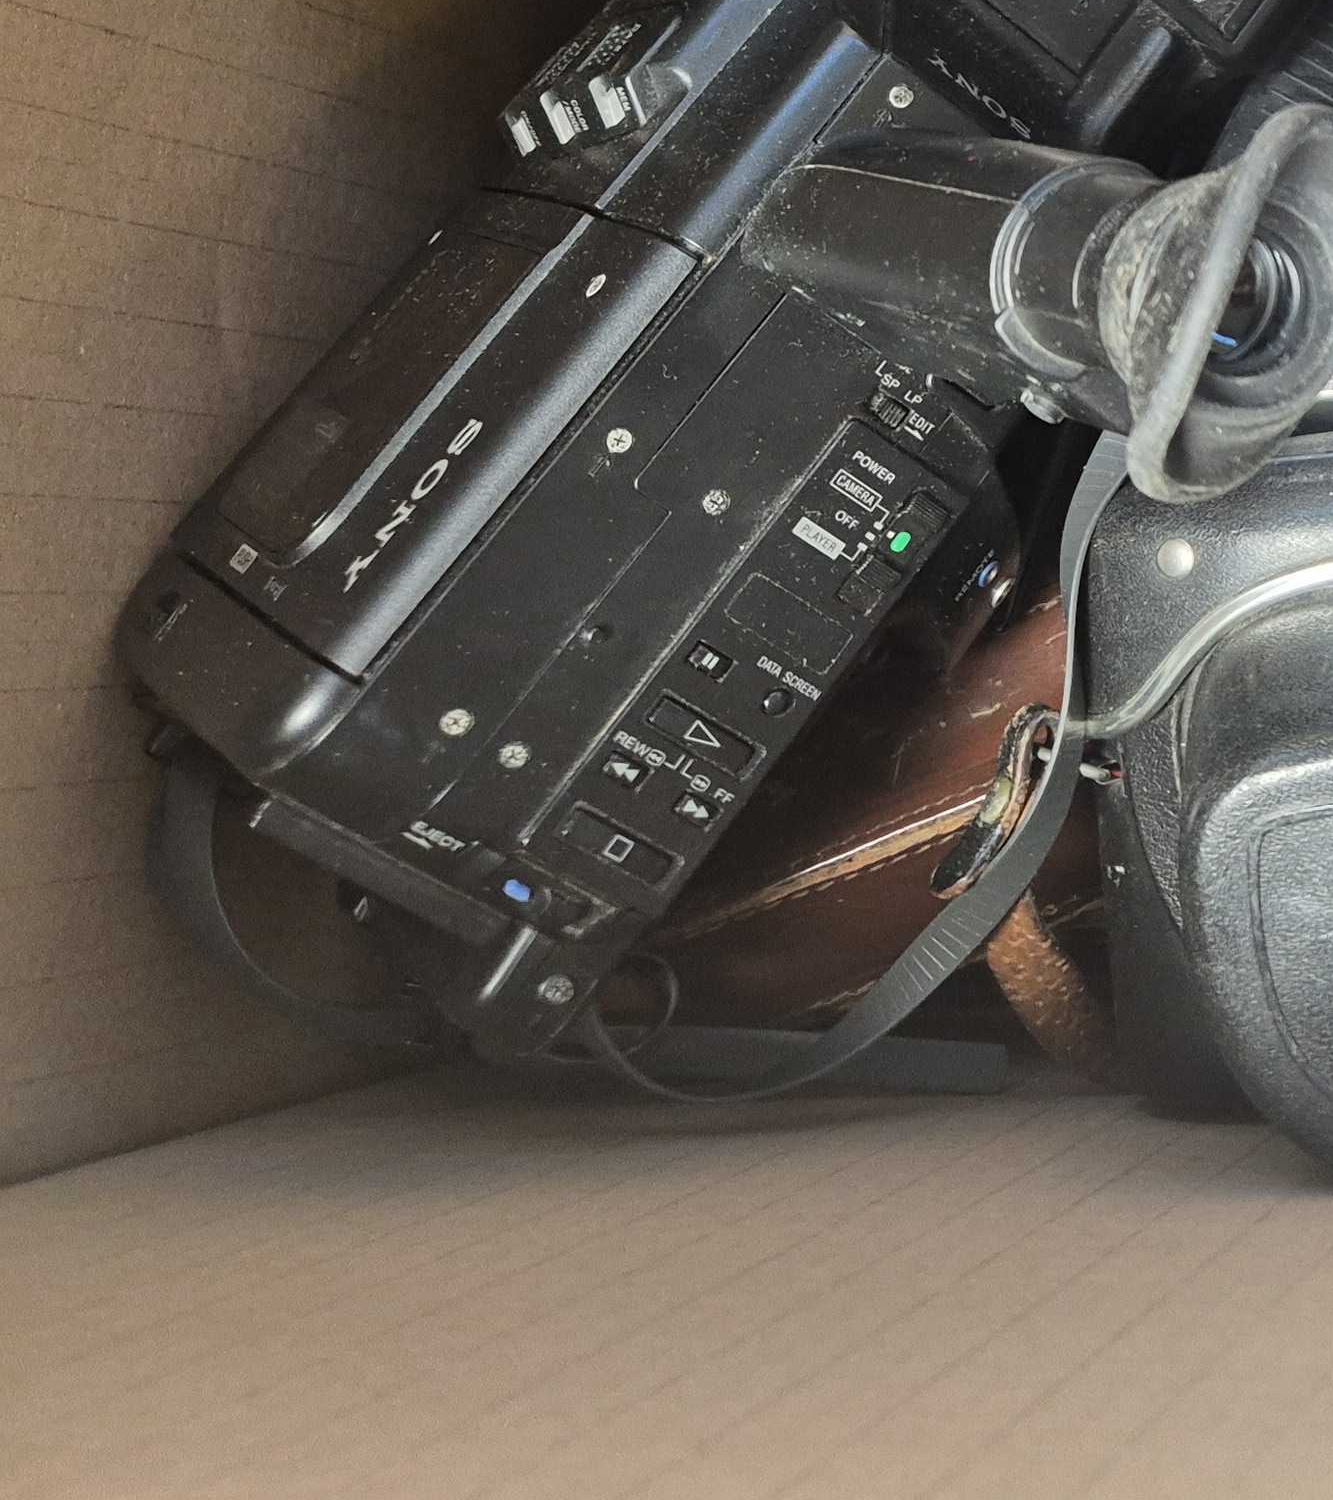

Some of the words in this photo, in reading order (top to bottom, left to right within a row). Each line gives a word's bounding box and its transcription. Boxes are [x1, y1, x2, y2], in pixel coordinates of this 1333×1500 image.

[926, 49, 1031, 140] SONY
[880, 372, 901, 389] SP
[903, 389, 924, 405] LP
[908, 410, 936, 435] EDIT
[852, 449, 896, 485] POWER
[342, 418, 484, 595] SONY
[835, 474, 876, 507] CAMERA
[834, 509, 860, 530] OFF
[800, 522, 837, 556] PLAYER
[756, 655, 783, 679] DATA
[781, 670, 824, 702] SCREEN
[612, 729, 650, 757] REW
[712, 787, 736, 804] FF
[410, 820, 467, 852] EJECT
